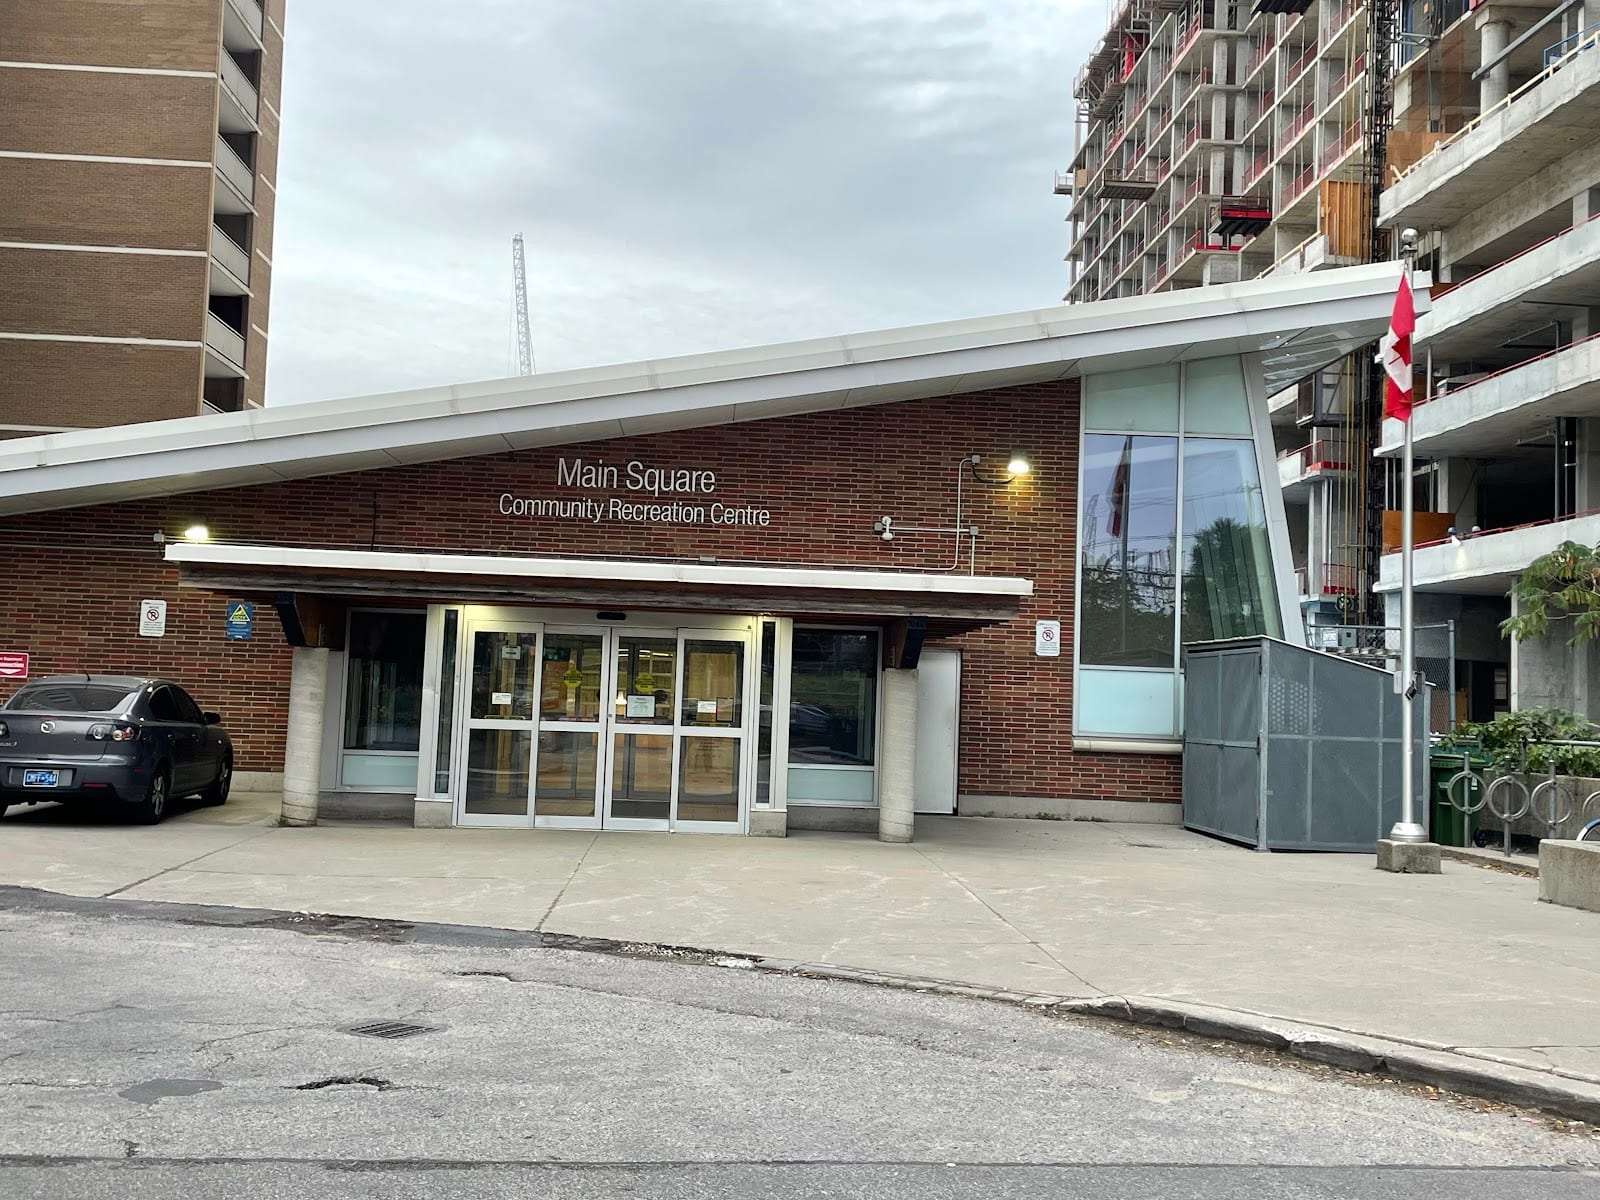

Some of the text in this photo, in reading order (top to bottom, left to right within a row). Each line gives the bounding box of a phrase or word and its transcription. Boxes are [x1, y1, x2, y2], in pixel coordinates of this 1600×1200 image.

[557, 457, 716, 498] Main Square
[499, 493, 770, 526] Community Recreation Centre
